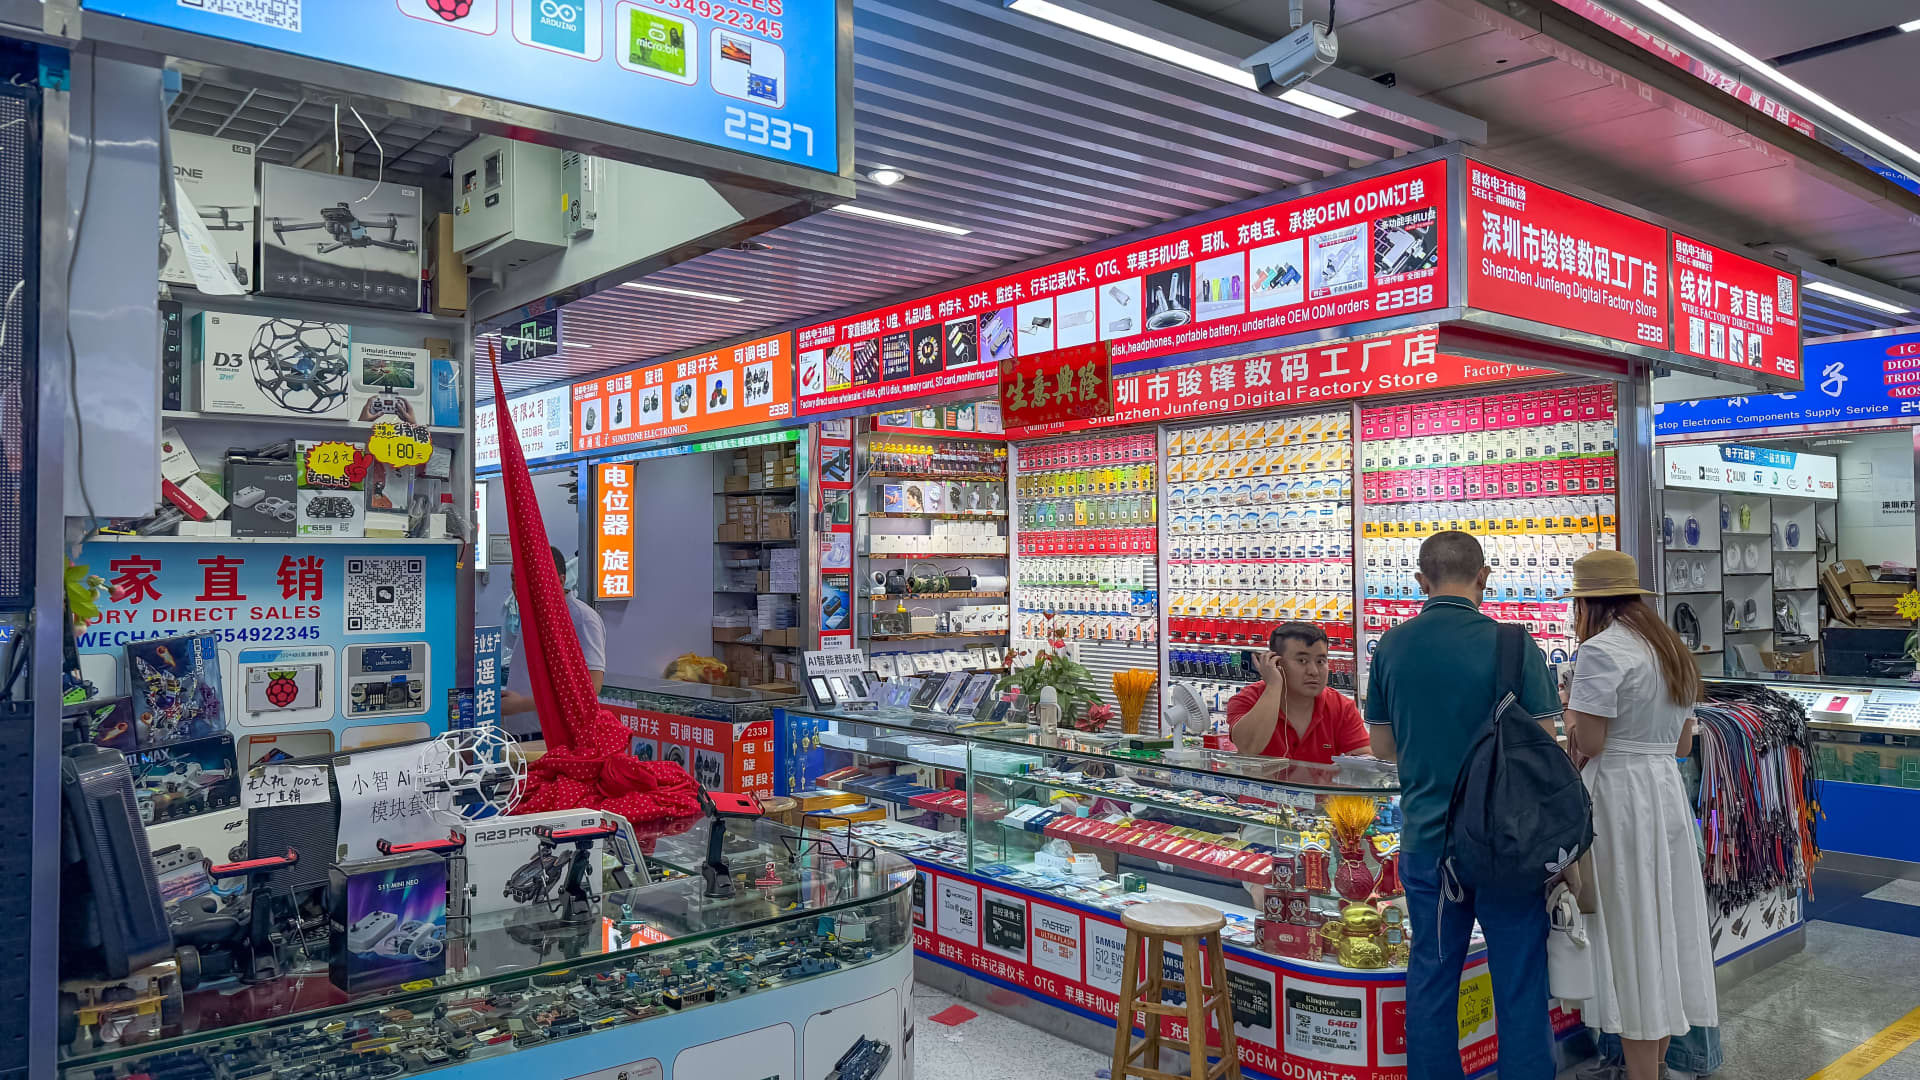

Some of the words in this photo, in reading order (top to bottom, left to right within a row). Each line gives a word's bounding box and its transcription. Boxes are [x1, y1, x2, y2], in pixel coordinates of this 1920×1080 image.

[540, 16, 577, 32] ARDUINO
[636, 37, 679, 57] micro:bit
[724, 106, 813, 157] 2337
[1471, 185, 1489, 202] SEG
[1481, 209, 1658, 300] 深圳市骏锋数码工厂店
[1375, 284, 1433, 312] 2338
[1481, 258, 1532, 287] Shenzhen
[1534, 270, 1572, 299] Junfeng
[1573, 279, 1601, 305] Digital
[1602, 289, 1635, 314] Factory
[1635, 297, 1658, 319] Store
[1680, 268, 1774, 326] 线材厂家直销
[1175, 328, 1208, 347] portable
[1209, 323, 1241, 340] battery,
[1242, 312, 1286, 333] undertake
[1287, 307, 1310, 323] OEM
[1311, 302, 1336, 320] ODM
[1337, 298, 1370, 315] orders
[1681, 302, 1699, 316] WIRE
[1700, 308, 1732, 325] FACTORY
[1731, 315, 1756, 332] DIRECT
[1756, 323, 1774, 336] SALES
[1637, 322, 1663, 343] 2338
[213, 351, 243, 368] D3
[606, 375, 632, 393] 电位器
[734, 339, 780, 364] 可调电阻
[1776, 356, 1796, 374] 2425
[935, 375, 943, 386] SD
[985, 367, 998, 380] card
[1464, 363, 1511, 378] Factory
[1820, 361, 1849, 398] 子
[1164, 396, 1229, 416] Junfeng
[1233, 385, 1291, 408] Digital
[1297, 376, 1373, 400] Factory
[1378, 369, 1438, 389] Store
[1682, 416, 1732, 428] Electronic
[1736, 410, 1800, 425] Components
[1804, 406, 1841, 419] Supply
[1846, 403, 1889, 415] Service
[644, 424, 688, 440] ELECTRONICS
[317, 450, 353, 465] 128元
[602, 465, 630, 536] 电位器
[601, 548, 630, 595] 旋钮
[152, 606, 239, 623] DIRECT
[250, 604, 321, 620] SALES
[808, 653, 862, 667] AI智能翻译机
[669, 721, 714, 746] 可调电阻
[746, 726, 768, 737] 2339
[293, 774, 324, 788] 100元
[352, 770, 388, 795] 小智
[397, 769, 411, 787] Ai
[475, 830, 506, 842] A23
[1041, 918, 1070, 935] FASTER
[1040, 930, 1057, 941] ULTRA
[1058, 936, 1075, 946] FLASH
[1095, 935, 1126, 951] SAMSUN
[1095, 947, 1110, 965] 512
[1295, 1001, 1358, 1018] ENDURANCE
[1305, 994, 1337, 1008] Kingston
[1327, 1018, 1358, 1029] 64GB
